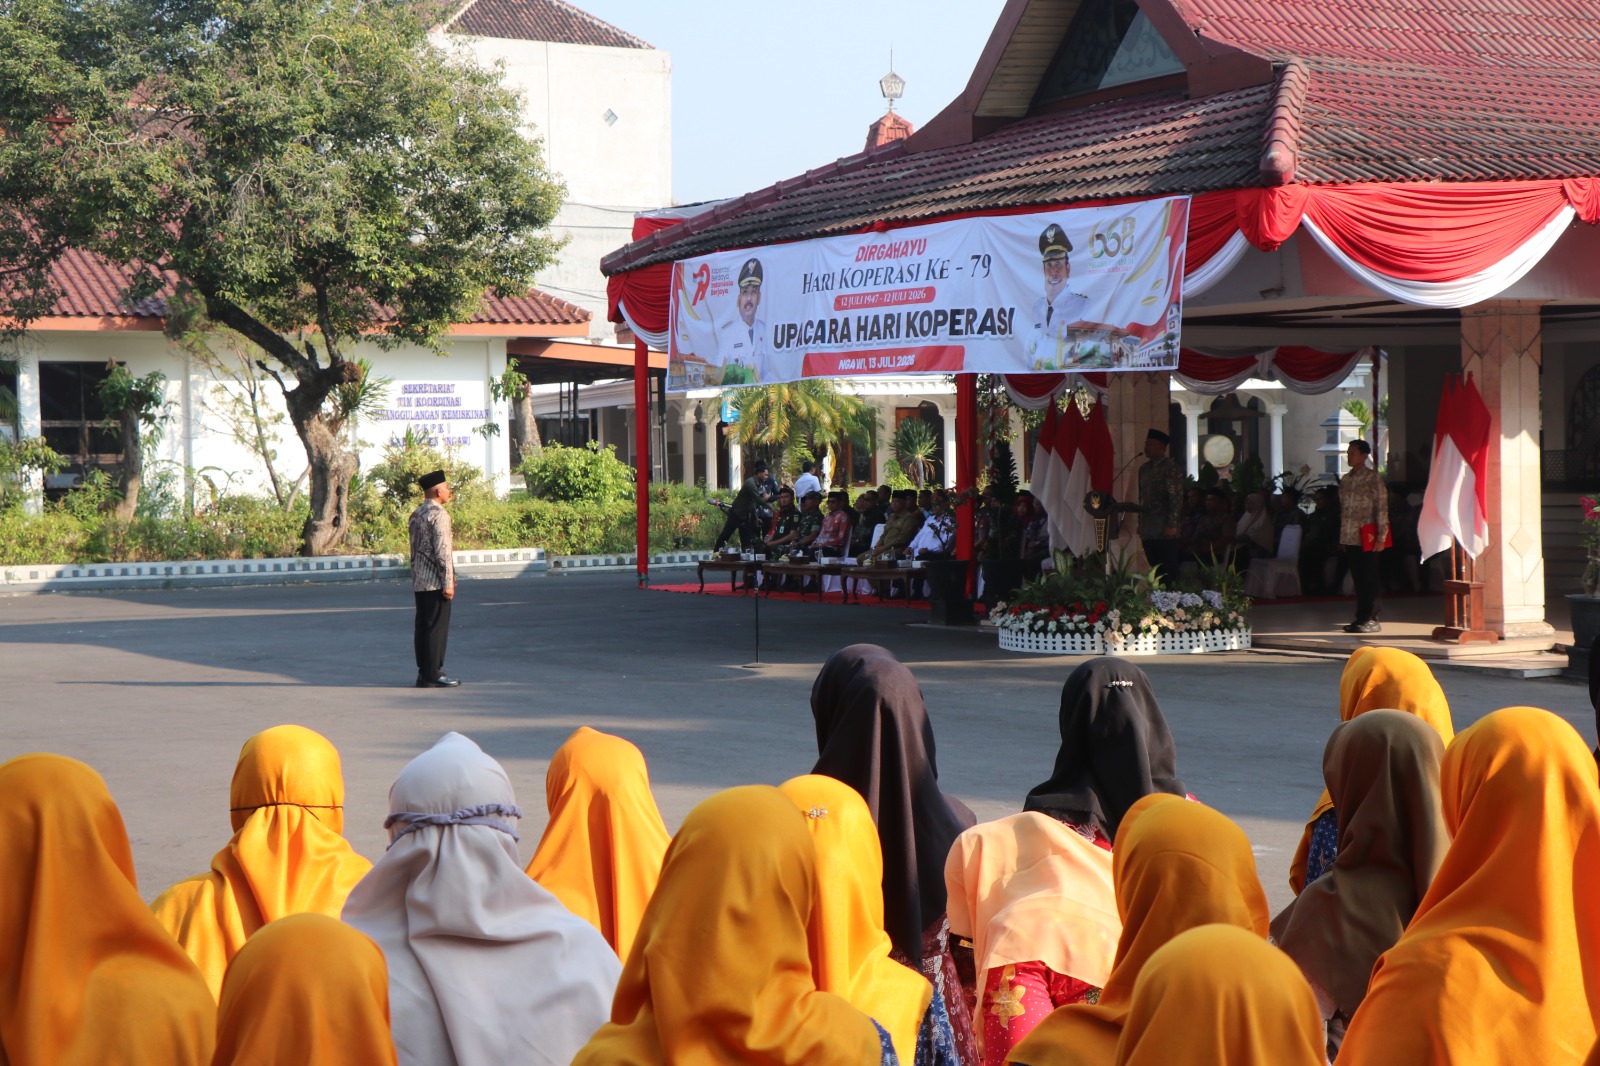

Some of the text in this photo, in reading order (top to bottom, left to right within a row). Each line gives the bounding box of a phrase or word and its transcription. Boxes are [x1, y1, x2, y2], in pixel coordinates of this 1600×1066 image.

[855, 238, 927, 262] DIRGAHAYU
[802, 271, 835, 294] HARI
[838, 262, 922, 290] KOPERASI
[925, 257, 950, 281] KE
[970, 253, 992, 279] 79
[711, 288, 728, 296] Berjaya
[841, 297, 847, 306] 12
[848, 296, 863, 307] JULI
[864, 294, 880, 305] 1947
[884, 293, 891, 303] 12
[891, 291, 907, 303] JULI
[908, 289, 926, 300] 2026
[773, 307, 1015, 349] UPACARA HARI KOPERASI
[838, 357, 867, 370] NGAWI,
[869, 357, 876, 369] 13
[877, 356, 896, 368] JULI
[402, 384, 455, 394] SEKRETARIAT
[397, 397, 462, 407] TIM KOORDINASI
[441, 409, 489, 420] KEMISKINAN
[445, 436, 471, 446] NGAWI
